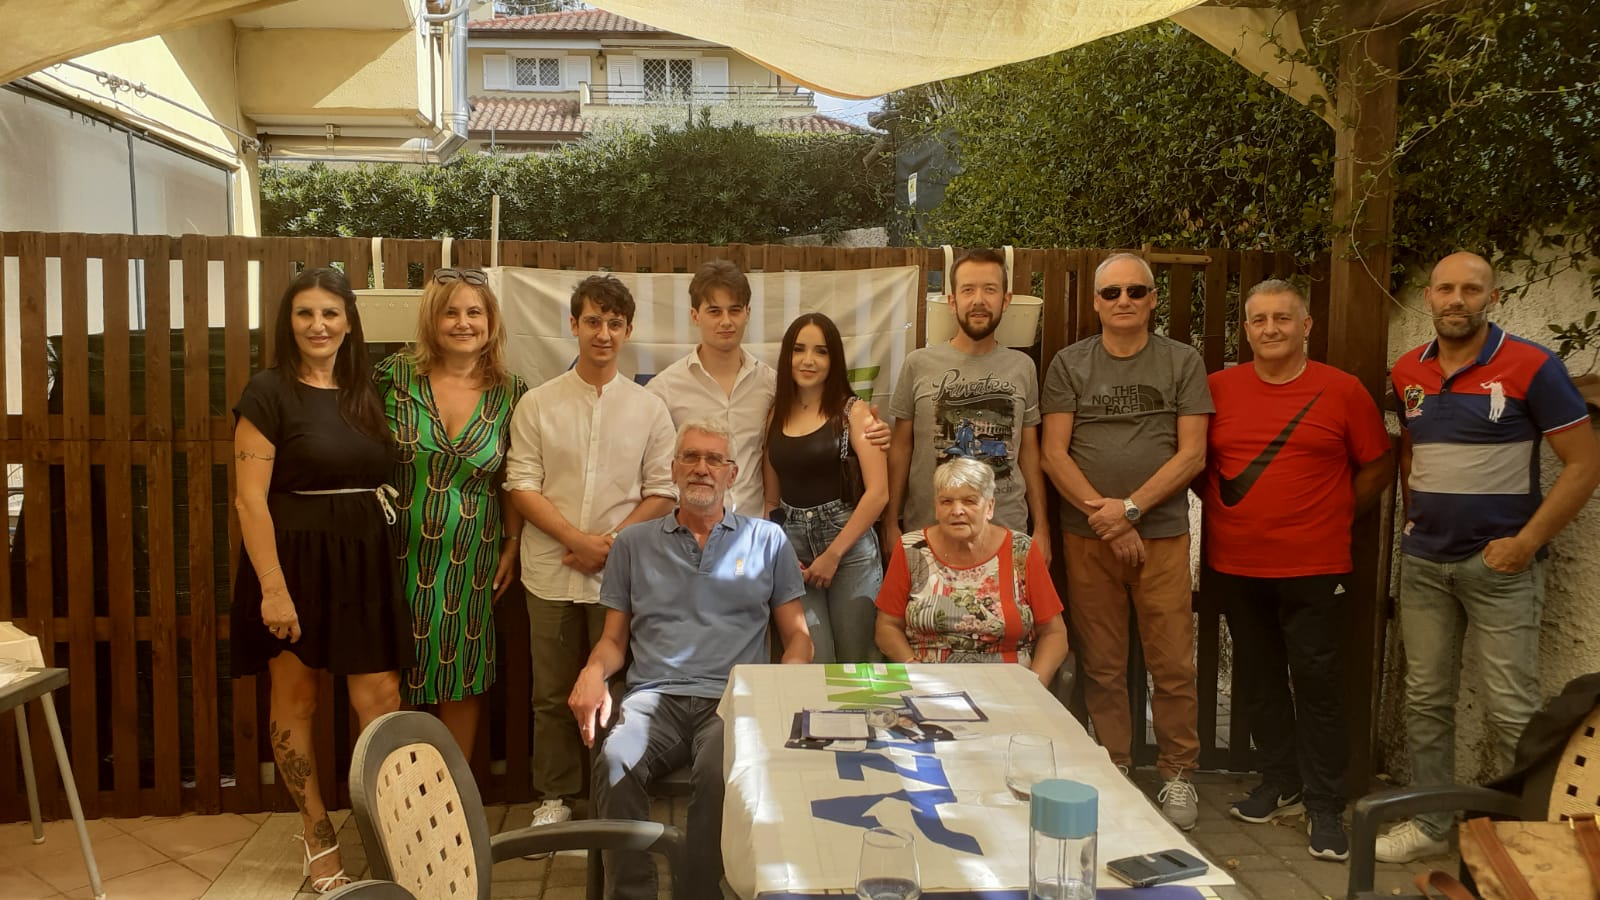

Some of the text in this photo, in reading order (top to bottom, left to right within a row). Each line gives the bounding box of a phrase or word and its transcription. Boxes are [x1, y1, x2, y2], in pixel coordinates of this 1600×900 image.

[1112, 384, 1137, 396] THE
[1092, 393, 1138, 405] NORTH
[1105, 403, 1139, 416] FACE
